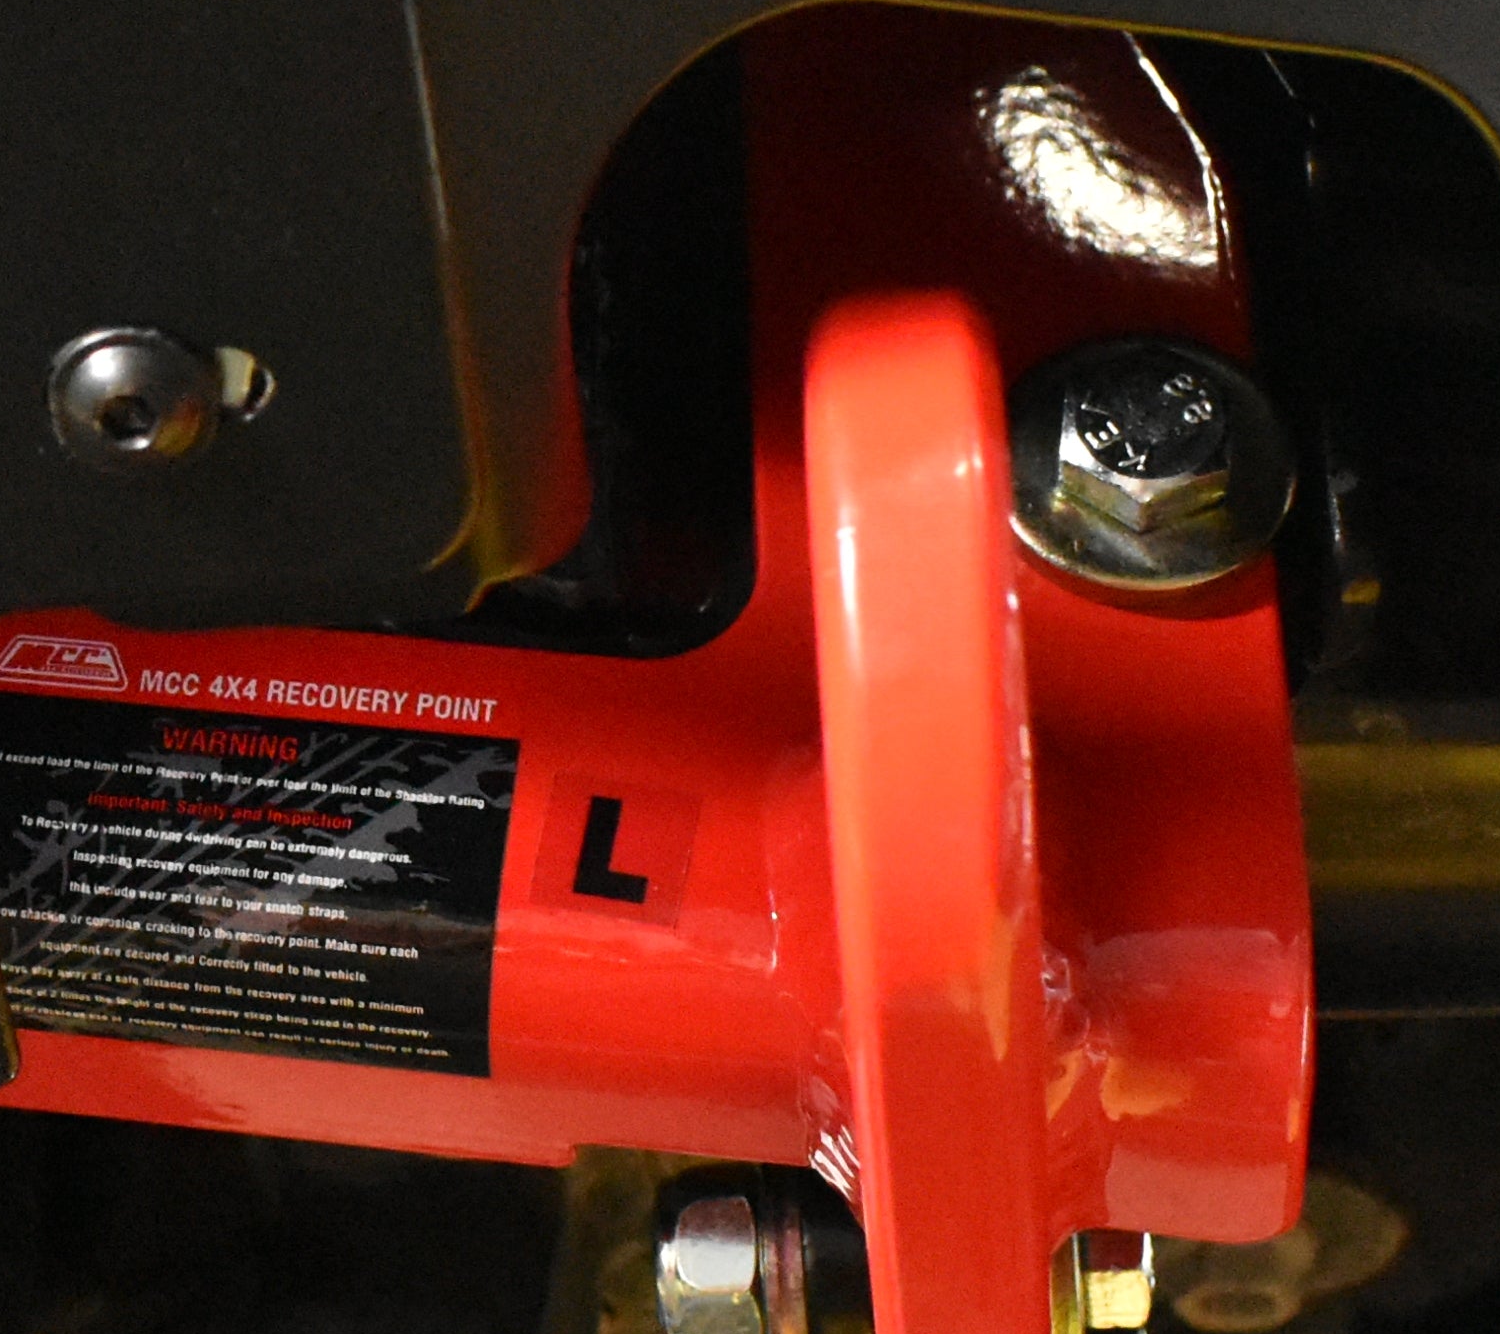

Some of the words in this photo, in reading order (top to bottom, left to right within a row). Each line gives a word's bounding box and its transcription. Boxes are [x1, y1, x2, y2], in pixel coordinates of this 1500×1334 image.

[139, 669, 200, 697] MCC
[209, 675, 258, 702] 4X4
[266, 679, 409, 715] RECOVERY
[416, 693, 498, 724] POINT
[162, 726, 299, 762] WARNING
[5, 753, 45, 766] exceed
[47, 756, 71, 768] load
[73, 757, 92, 769] the
[93, 759, 119, 772] limit
[121, 761, 133, 773] of
[135, 763, 153, 776] the
[156, 766, 207, 783] Recovery
[210, 770, 239, 785] Point
[240, 774, 252, 785] or
[256, 777, 280, 788] over
[283, 778, 307, 791] load
[310, 780, 328, 793] the
[331, 781, 357, 796] limit
[360, 784, 373, 796] of
[374, 786, 392, 799] the
[448, 793, 486, 809] Rating
[176, 799, 226, 821] Safety
[230, 806, 263, 822] and
[267, 808, 354, 830] Inspection
[20, 814, 34, 827] To
[36, 816, 88, 833] Recovery
[102, 824, 142, 837] vehicle
[144, 827, 183, 844] during
[245, 838, 267, 850] can
[270, 838, 285, 853] be
[287, 841, 346, 860] extremely
[348, 847, 412, 864] dangerous.
[572, 795, 649, 905] L
[73, 849, 133, 869] Inspecting
[135, 857, 184, 873] recovery
[188, 862, 251, 879] equipment
[253, 866, 269, 879] for
[272, 870, 294, 886] any
[69, 880, 91, 894] this
[93, 882, 137, 899] include
[139, 888, 167, 901] wear
[170, 891, 191, 904] and
[221, 896, 233, 908] to
[236, 899, 263, 914] your
[265, 901, 305, 916] snatch
[70, 913, 82, 925] or
[145, 920, 195, 938] cracking
[198, 926, 211, 938] to
[214, 927, 233, 941] the
[234, 930, 286, 948] recovery
[288, 936, 322, 951] point.
[324, 938, 358, 953] Make
[361, 944, 387, 956] sure
[389, 945, 419, 960] each
[39, 940, 101, 955] equipment
[103, 946, 122, 957] are
[124, 948, 170, 963] secured
[174, 953, 195, 966] and
[198, 955, 250, 972] Correctly
[254, 960, 284, 974] fitted
[287, 963, 300, 976] to
[303, 965, 321, 978] the
[91, 970, 102, 980] at
[115, 974, 139, 985] safe
[142, 976, 191, 991] distance
[194, 981, 222, 995] from
[225, 984, 243, 997] the
[247, 987, 297, 1004] recovery
[300, 993, 326, 1006] area
[330, 995, 355, 1008] with
[369, 1000, 425, 1015] minimum
[154, 1001, 165, 1011] of
[169, 1001, 187, 1012] the
[190, 1005, 239, 1019] recovery
[276, 1013, 309, 1027] being
[312, 1017, 340, 1029] used
[342, 1020, 354, 1030] in
[357, 1021, 377, 1033] the
[181, 1022, 241, 1035] equipment
[244, 1029, 266, 1038] can
[269, 1031, 302, 1042] result
[319, 1036, 361, 1048] serious
